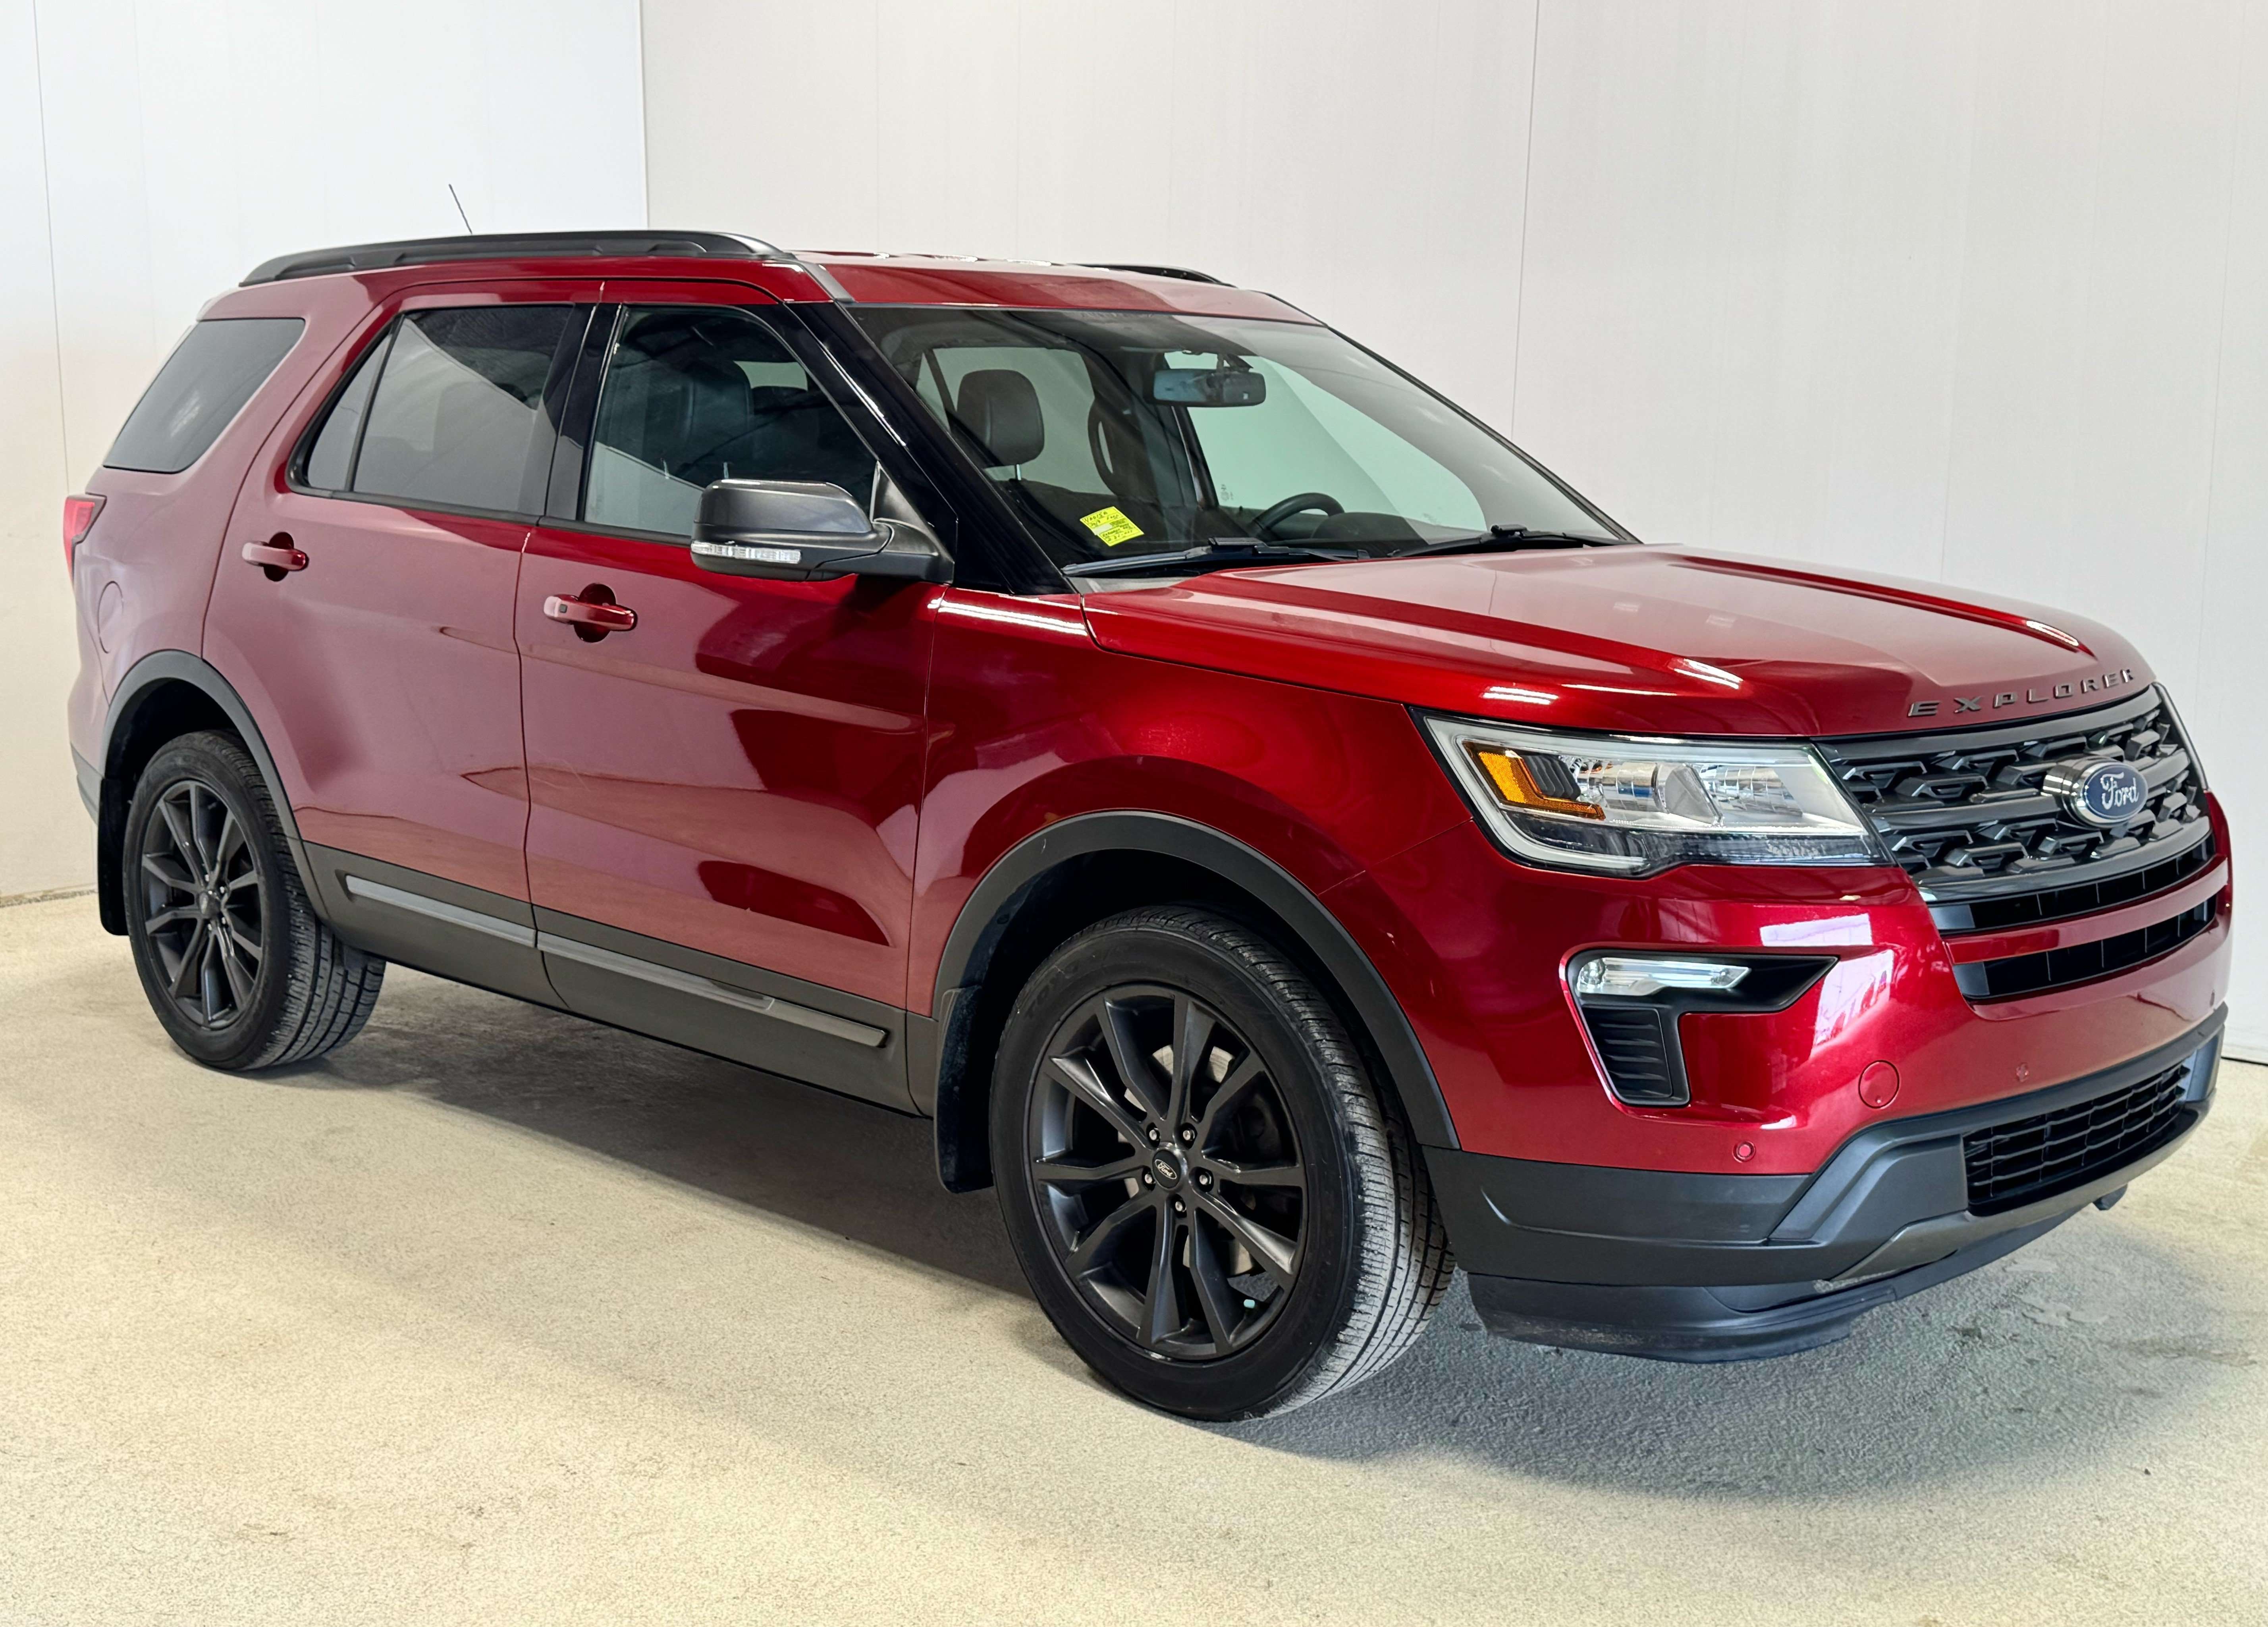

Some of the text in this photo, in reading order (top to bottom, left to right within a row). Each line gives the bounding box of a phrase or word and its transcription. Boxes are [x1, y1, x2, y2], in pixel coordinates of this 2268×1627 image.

[1907, 669, 2133, 717] EXPLORER
[2100, 772, 2139, 810] Ford
[1158, 1162, 1173, 1177] Ford
